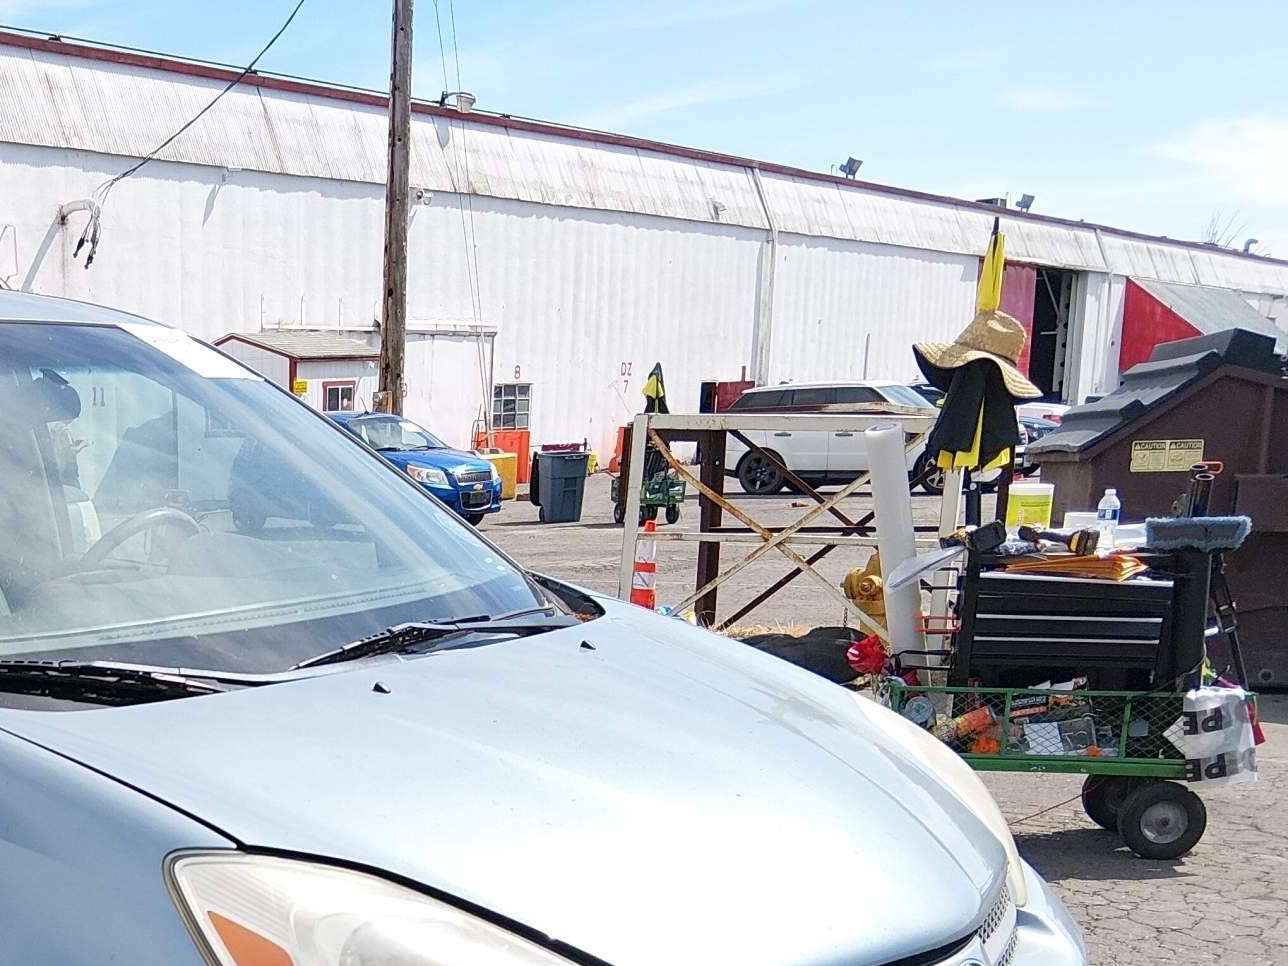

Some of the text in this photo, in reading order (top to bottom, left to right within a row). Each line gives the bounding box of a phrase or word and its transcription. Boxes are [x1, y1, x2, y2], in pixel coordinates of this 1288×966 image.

[514, 365, 521, 379] 8
[620, 362, 632, 376] DZ
[623, 379, 629, 393] 7
[92, 386, 106, 407] 11
